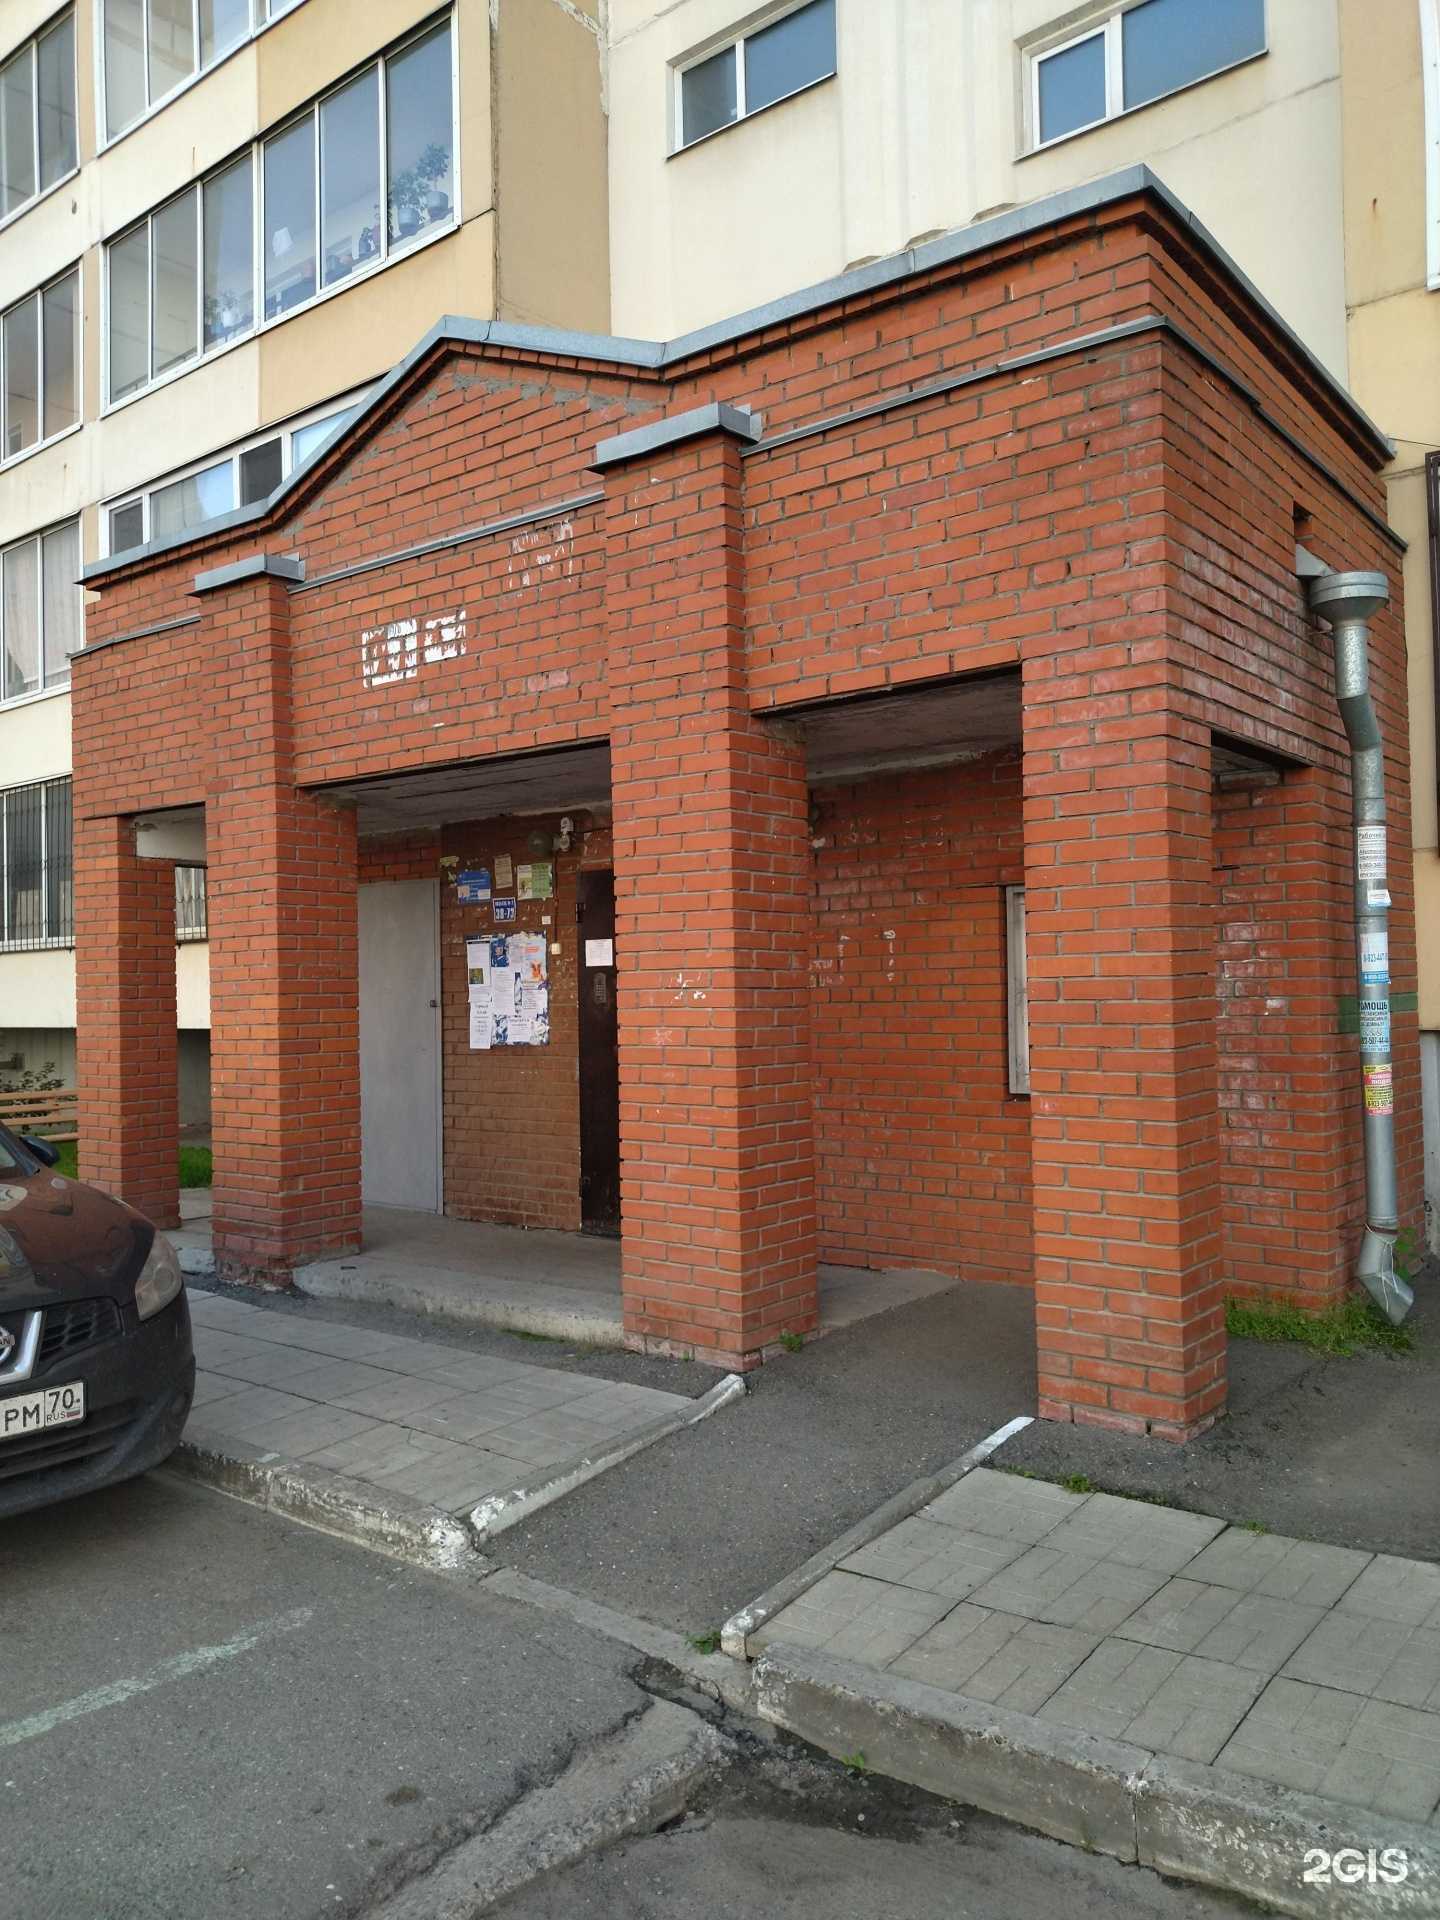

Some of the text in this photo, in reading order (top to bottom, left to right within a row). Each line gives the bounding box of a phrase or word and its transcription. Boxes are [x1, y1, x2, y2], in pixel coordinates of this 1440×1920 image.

[1360, 1001, 1388, 1011] ОМОЩЬ
[48, 1388, 75, 1415] 70
[4, 1403, 40, 1432] PM
[46, 1410, 66, 1422] RUS
